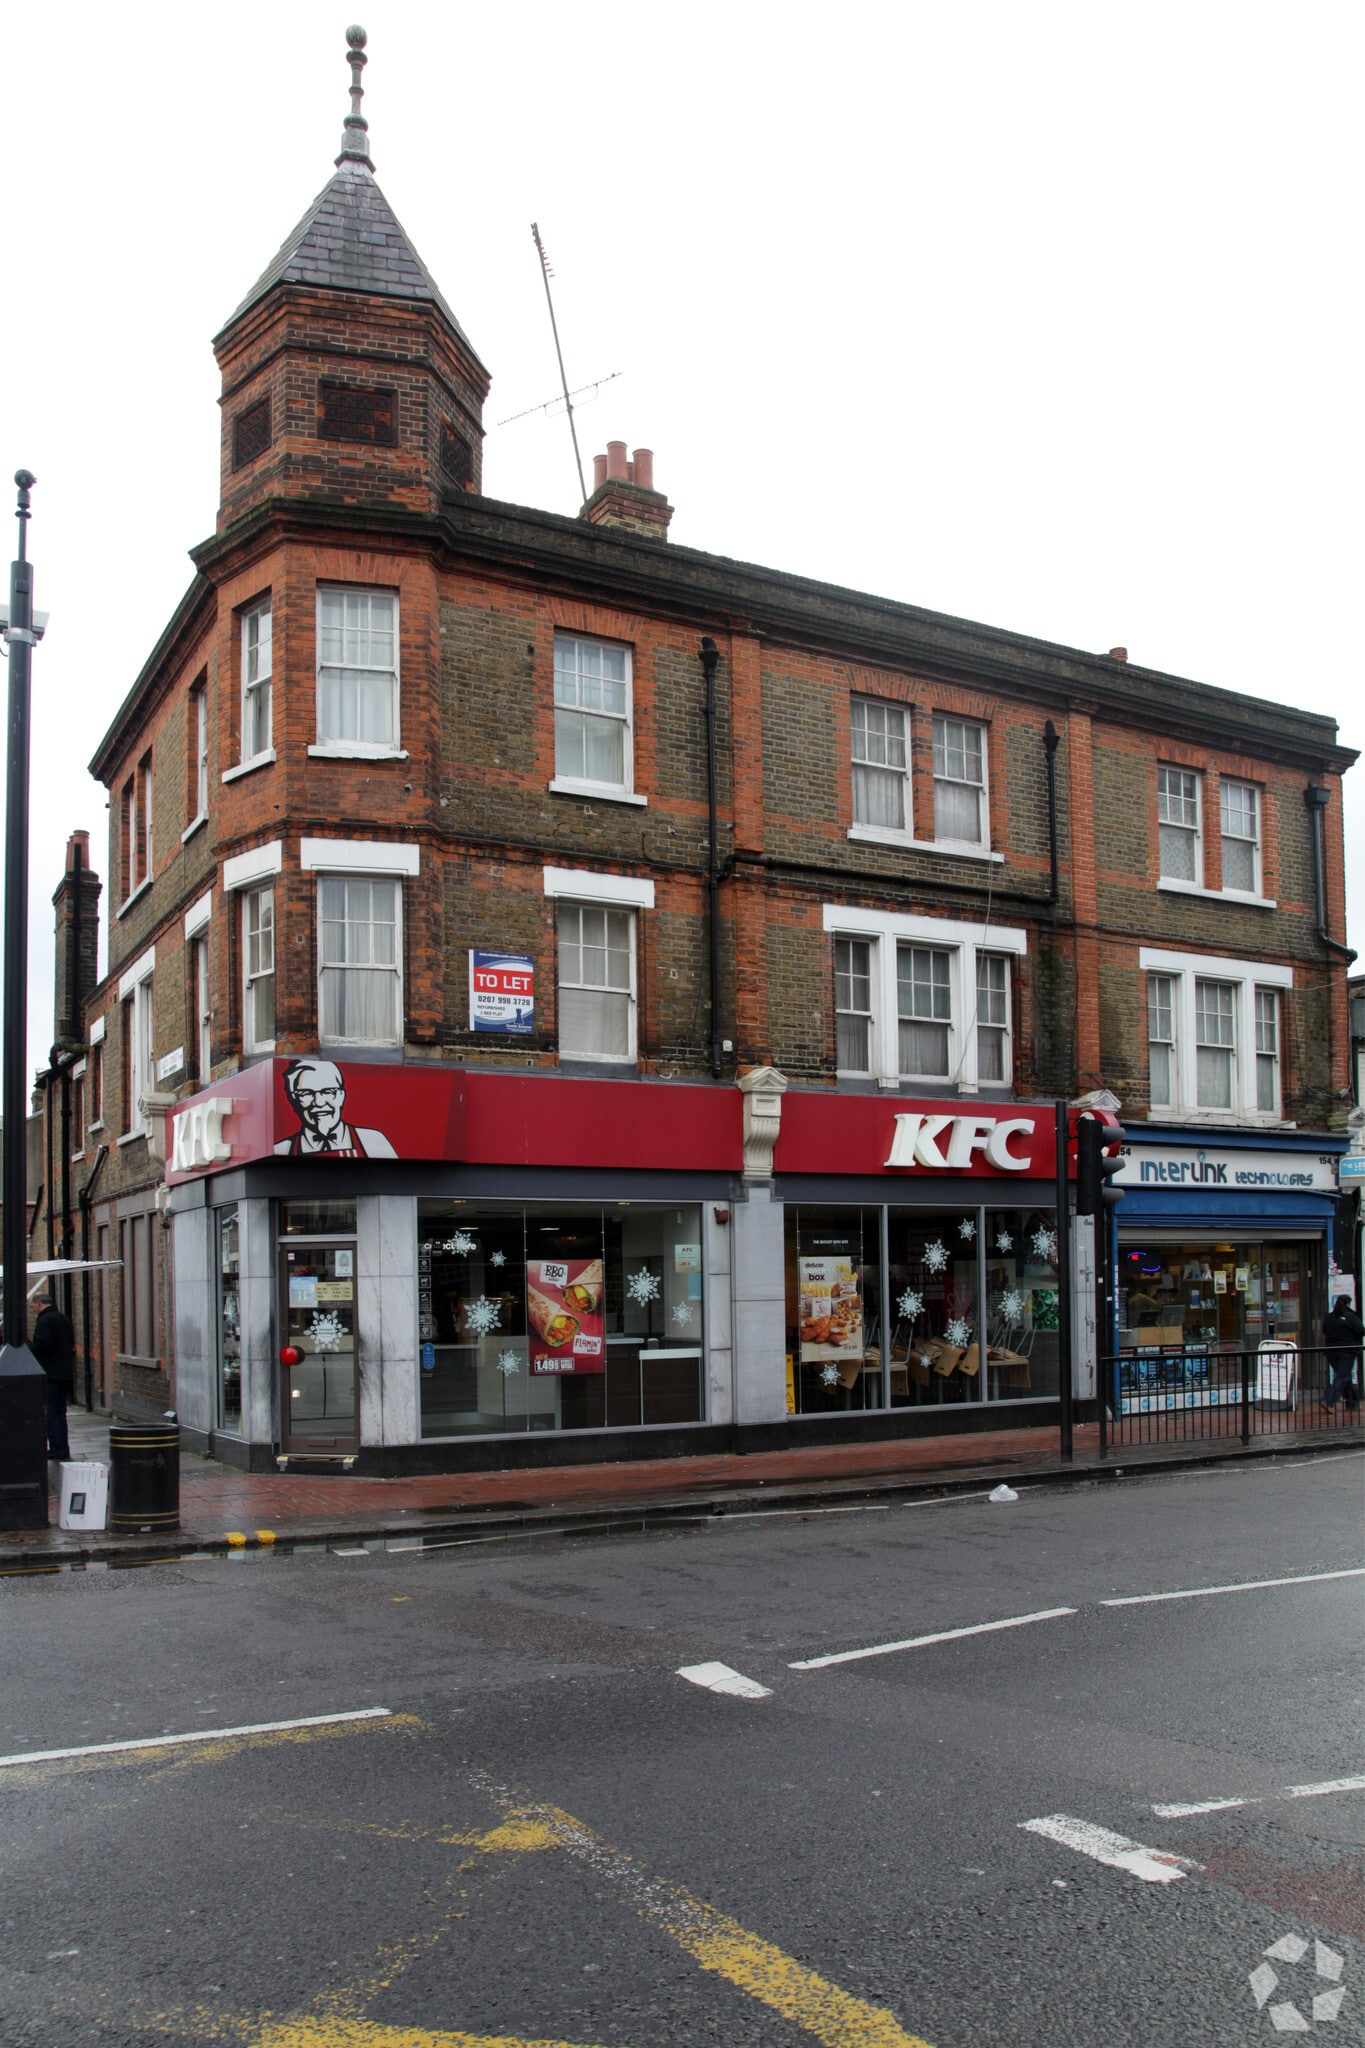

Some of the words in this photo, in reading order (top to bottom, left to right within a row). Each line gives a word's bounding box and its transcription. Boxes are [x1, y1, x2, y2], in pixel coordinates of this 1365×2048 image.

[476, 973, 498, 988] TO
[503, 976, 531, 990] LET
[477, 995, 495, 1003] 0207
[497, 997, 511, 1005] 998
[513, 998, 530, 1006] 3728
[171, 1097, 233, 1173] KFC
[883, 1113, 1036, 1171] KFC
[1319, 1156, 1331, 1165] 154
[545, 1265, 564, 1278] BBQ
[808, 1273, 825, 1281] box
